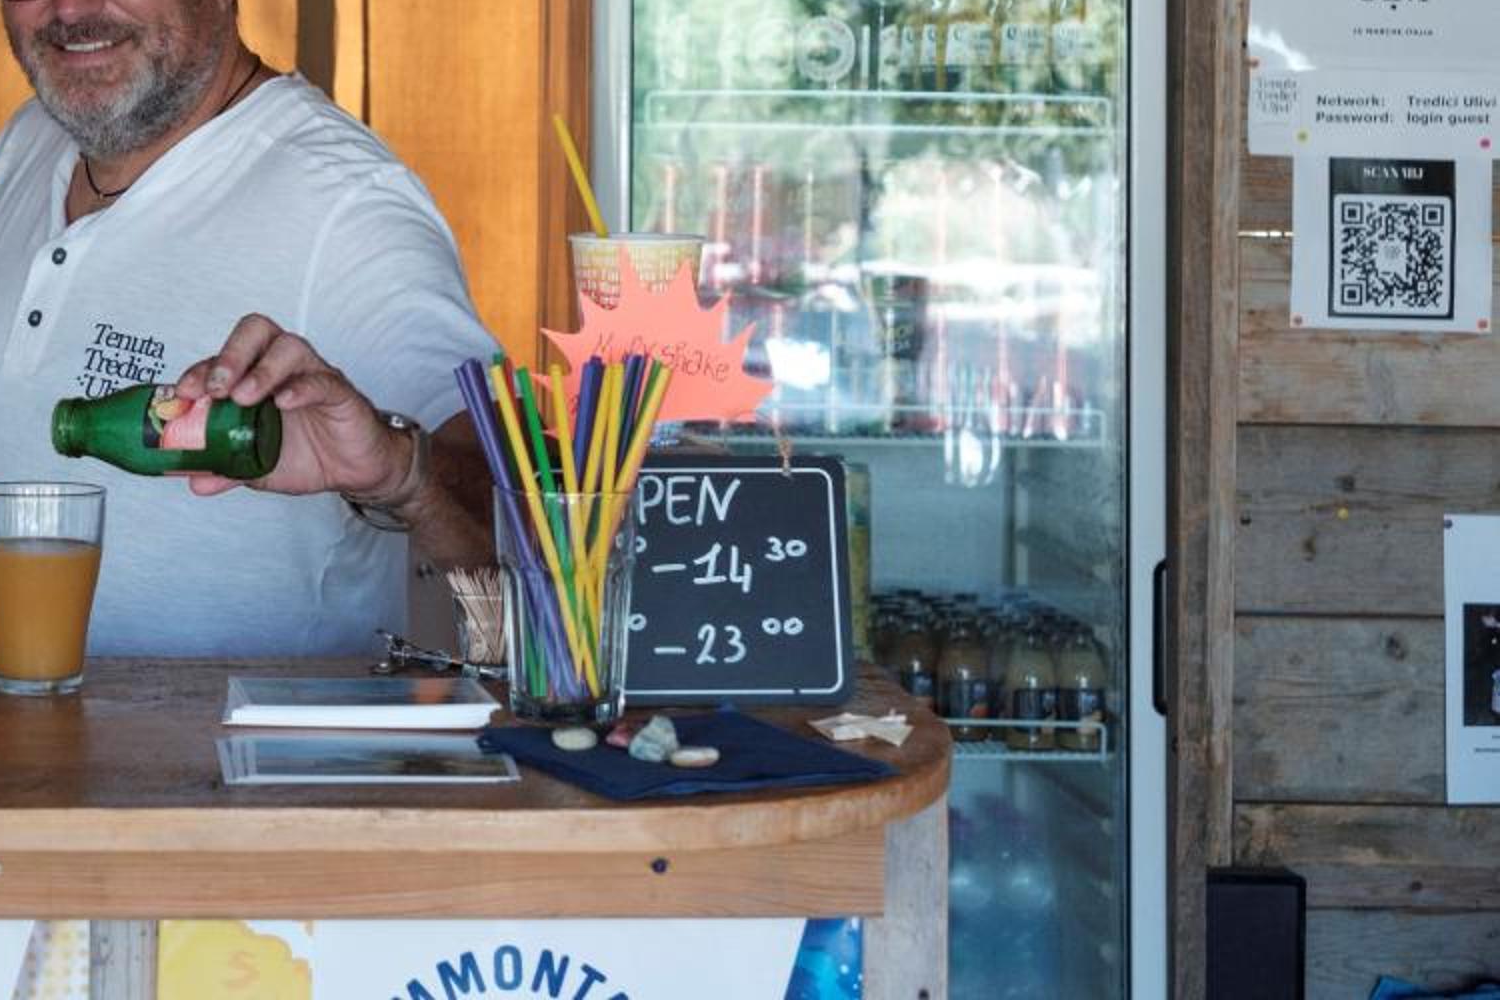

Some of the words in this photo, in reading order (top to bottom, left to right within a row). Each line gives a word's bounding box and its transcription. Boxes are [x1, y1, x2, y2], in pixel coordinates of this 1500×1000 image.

[1316, 95, 1386, 107] Network:
[1407, 95, 1458, 107] Tredici
[1464, 95, 1497, 108] Ulivi
[1316, 111, 1393, 124] Password:
[1407, 112, 1443, 126] login
[1448, 113, 1490, 126] guest
[93, 323, 165, 359] Tenuta
[84, 347, 159, 384] Tredici
[637, 475, 741, 526] PEN
